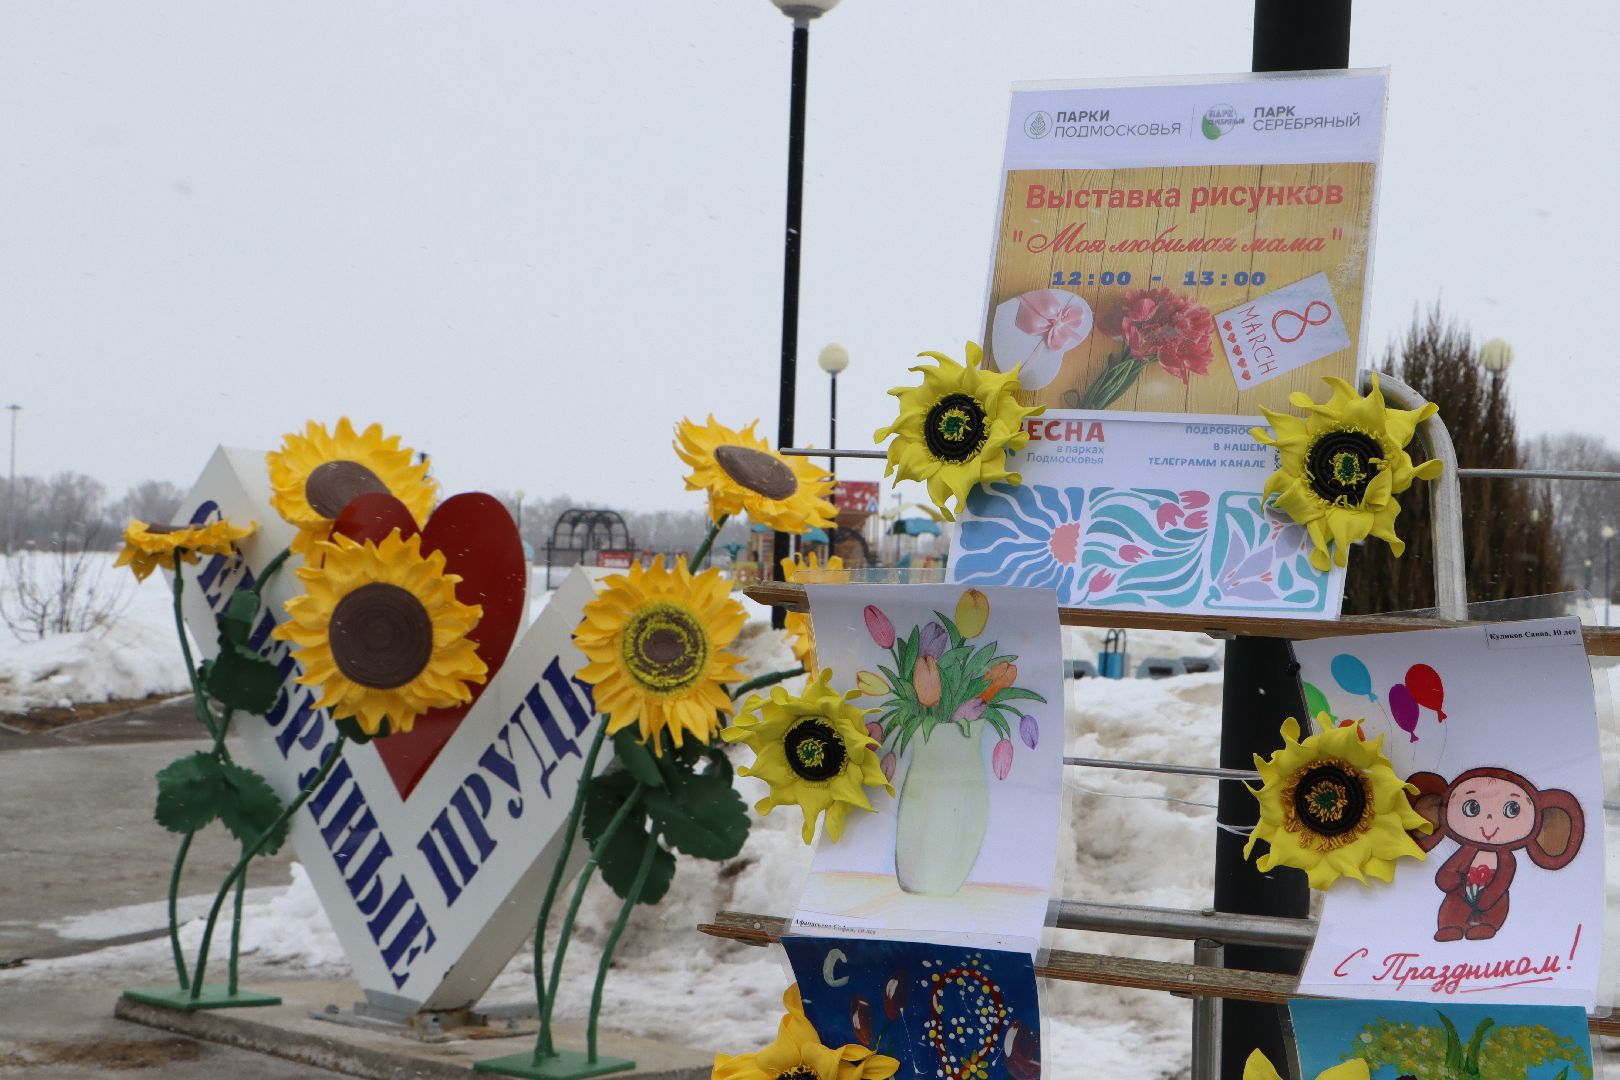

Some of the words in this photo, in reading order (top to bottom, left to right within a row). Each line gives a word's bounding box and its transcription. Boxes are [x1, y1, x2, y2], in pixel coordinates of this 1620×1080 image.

[1056, 110, 1110, 123] ПАРКИ
[1254, 106, 1296, 118] ПАРК
[1253, 111, 1361, 131] СЕРЕБРЯНЫЙ
[1054, 122, 1181, 138] ПОДМОСКОВЬЯ
[1026, 184, 1181, 209] Выставка
[1190, 184, 1344, 214] рисунков
[1109, 225, 1238, 253] любимая
[1051, 271, 1132, 286] 12:00
[1182, 271, 1267, 286] 13:00
[1237, 305, 1278, 376] MARCH
[1019, 420, 1105, 442] ЕСНА
[1057, 445, 1063, 453] в
[1065, 445, 1104, 454] парках
[1224, 443, 1267, 452] НАШЕМ
[1027, 453, 1104, 465] Подмосковья
[1149, 457, 1216, 467] ТЕЛЕГРАММ
[1220, 459, 1266, 468] КАНАЛЕ
[1489, 633, 1523, 641] Куликов
